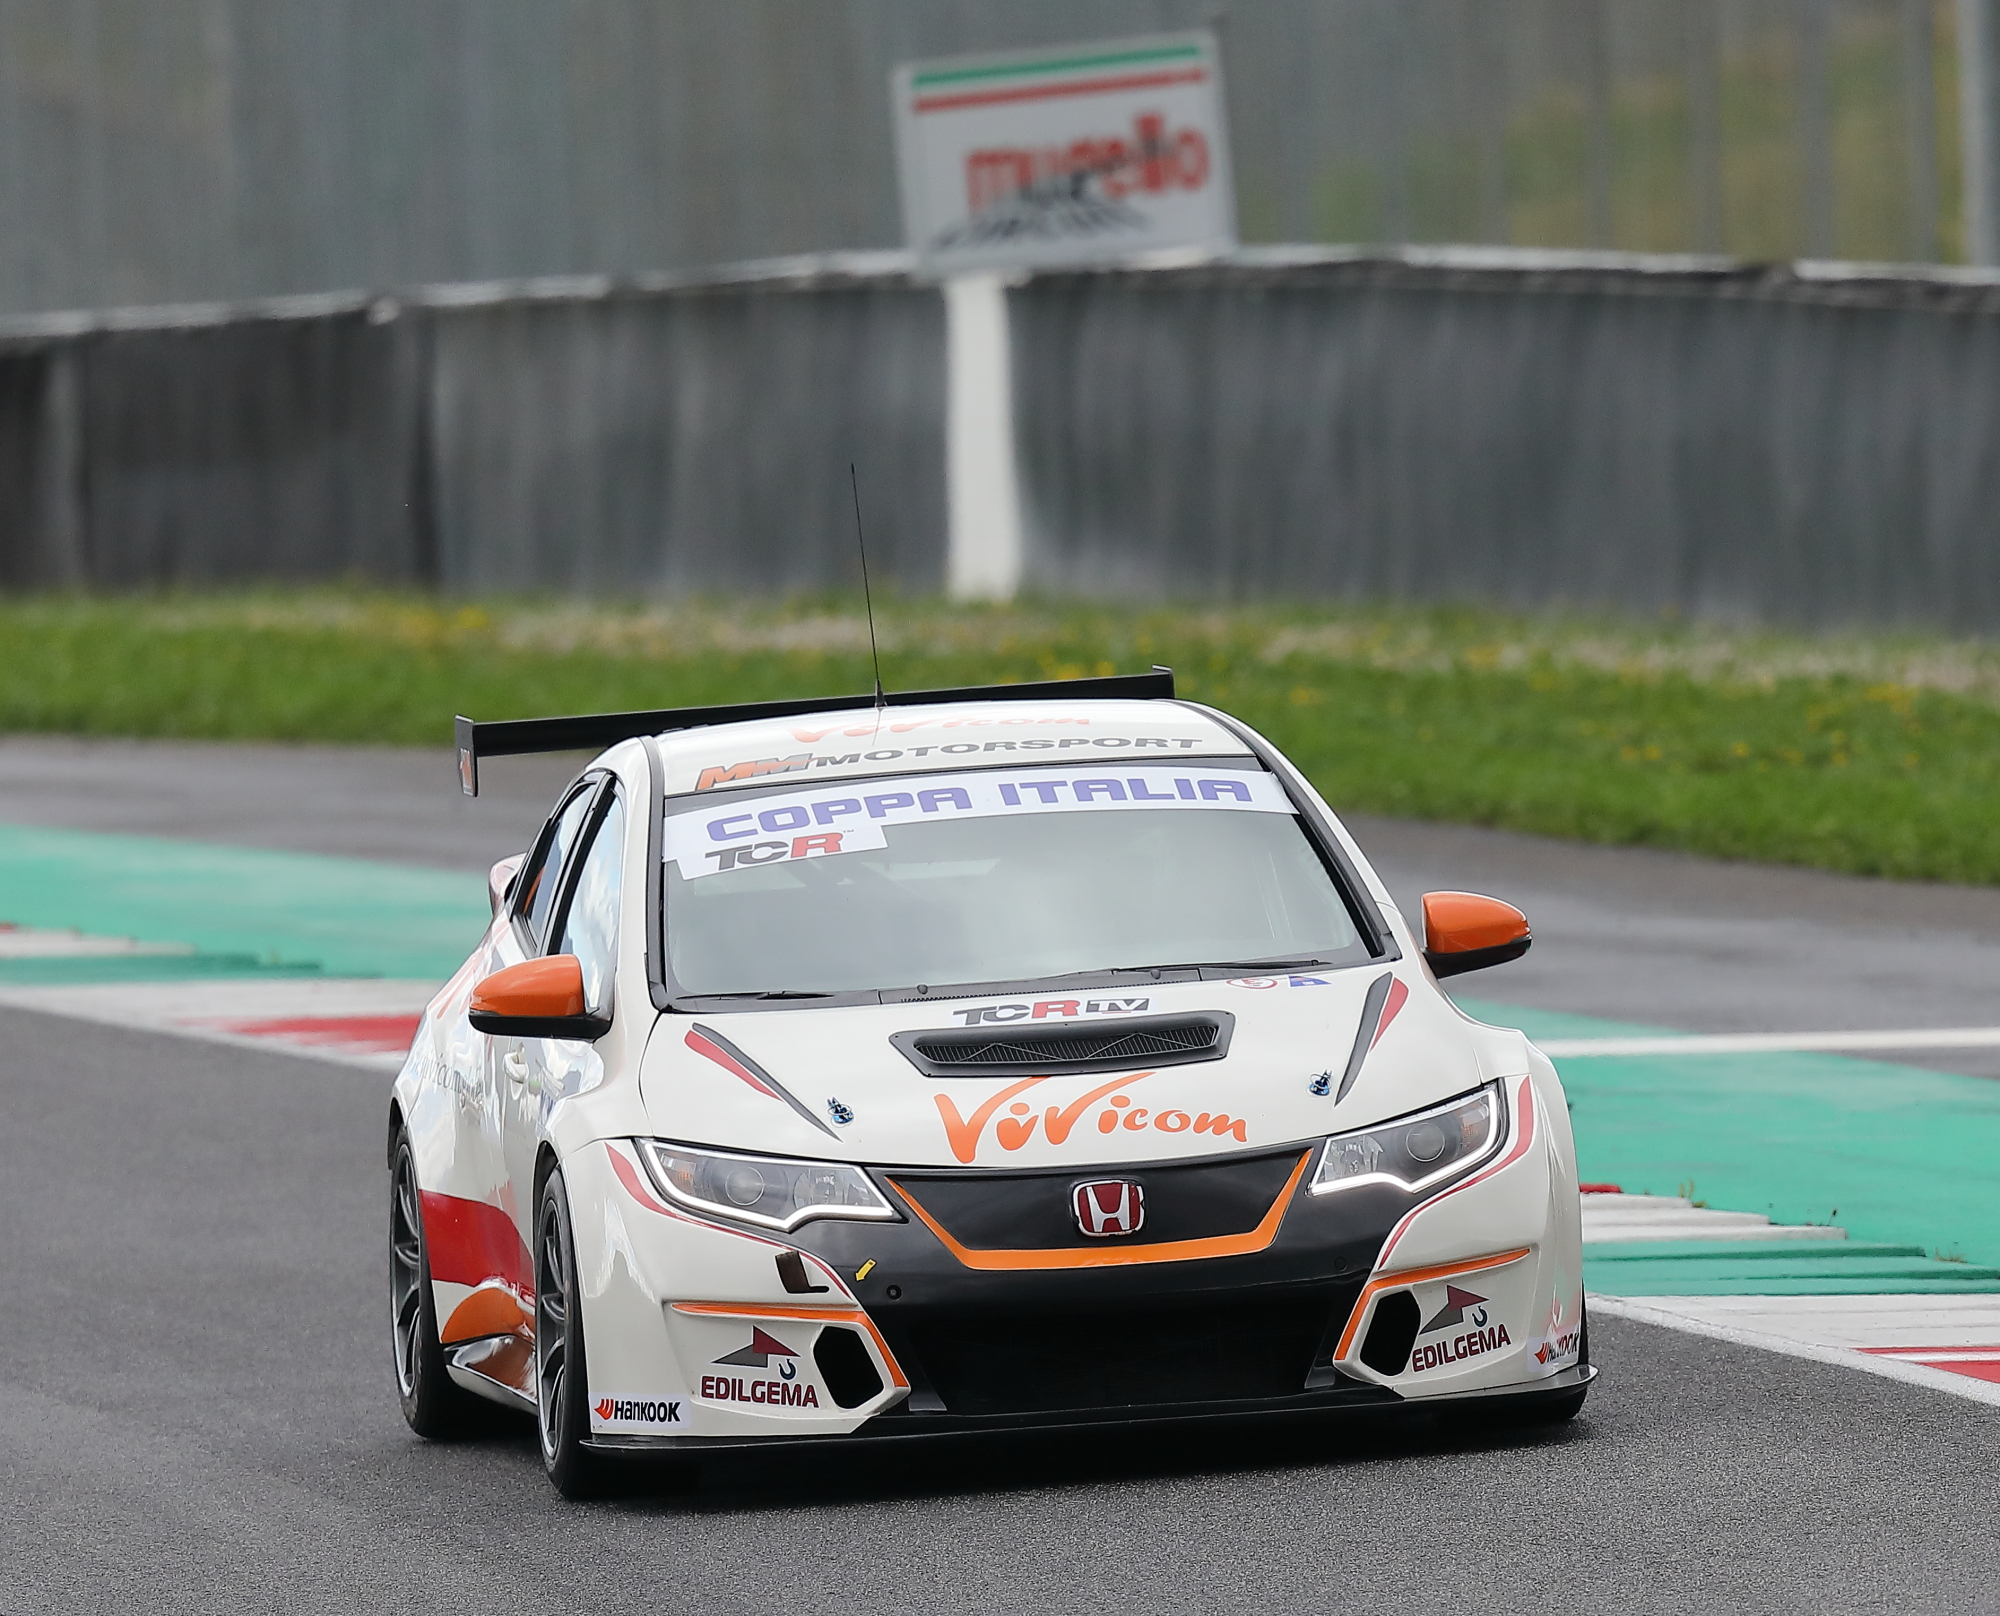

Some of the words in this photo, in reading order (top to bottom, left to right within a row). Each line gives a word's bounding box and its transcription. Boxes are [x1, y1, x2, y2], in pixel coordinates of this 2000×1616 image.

[815, 738, 1203, 767] MOTORSPORT
[706, 787, 973, 841] COPPA
[998, 778, 1253, 806] ITALIA
[704, 832, 844, 871] TCR
[952, 999, 1080, 1026] TCR
[1412, 1324, 1512, 1372] EDILGEMA
[701, 1376, 819, 1408] EDILGEMA
